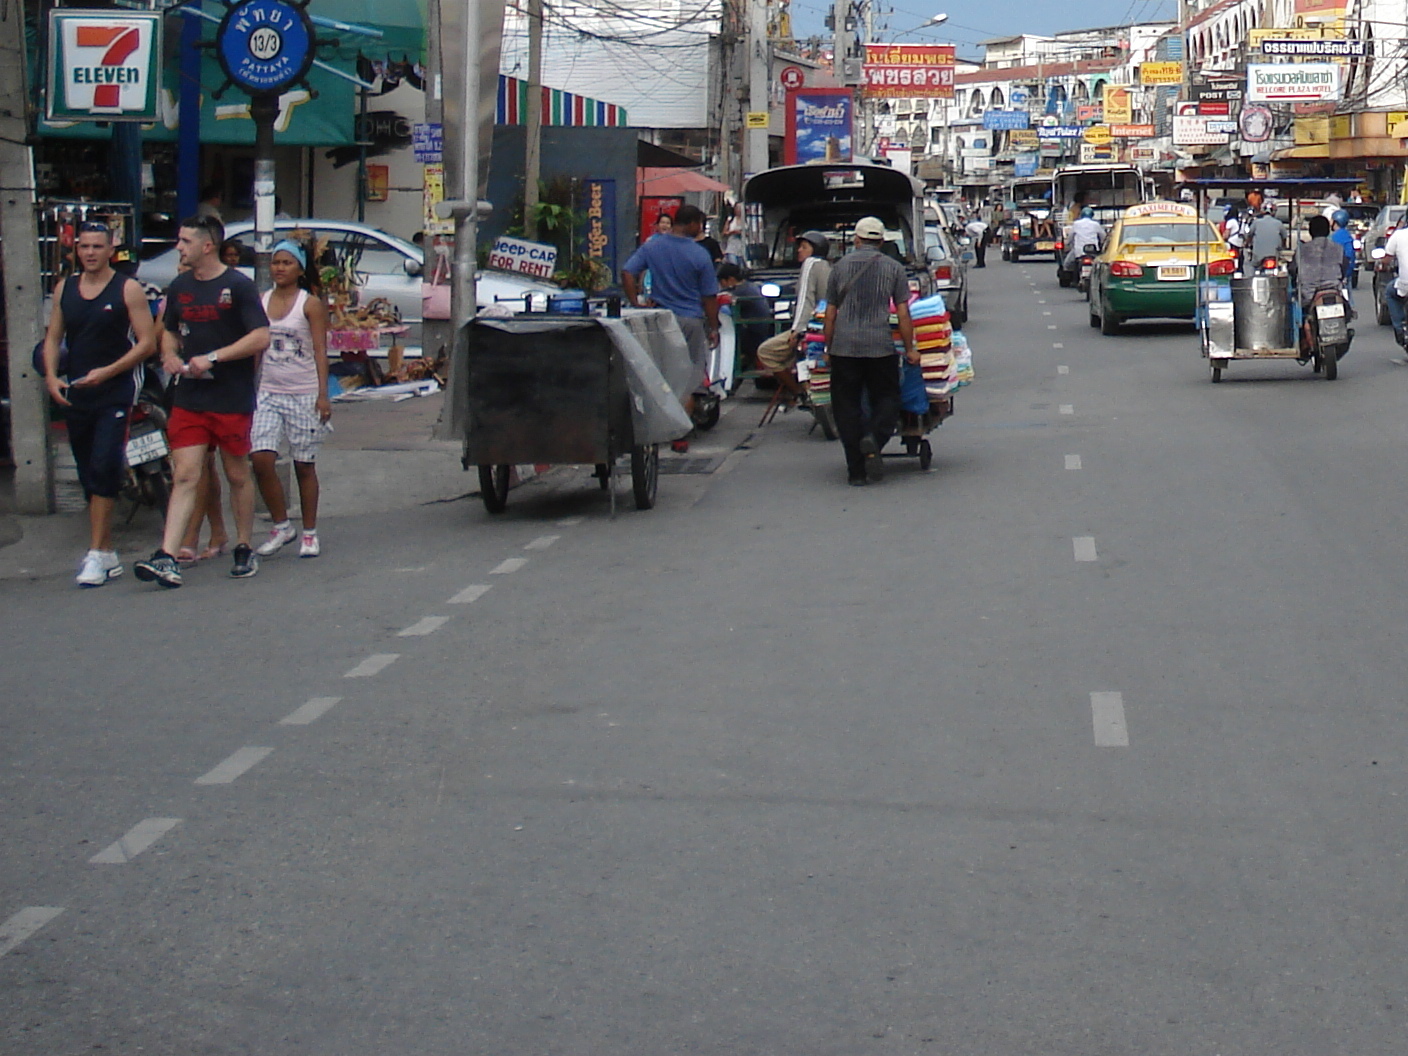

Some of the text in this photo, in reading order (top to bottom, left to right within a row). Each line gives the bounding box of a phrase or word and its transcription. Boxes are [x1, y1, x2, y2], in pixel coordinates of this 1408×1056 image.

[235, 7, 294, 33] พัทยา
[254, 34, 278, 52] 13/3
[242, 56, 290, 74] PATTAYA
[1112, 127, 1152, 137] Internet
[588, 183, 608, 258] Tiger Beer
[490, 253, 552, 278] FOR RENT
